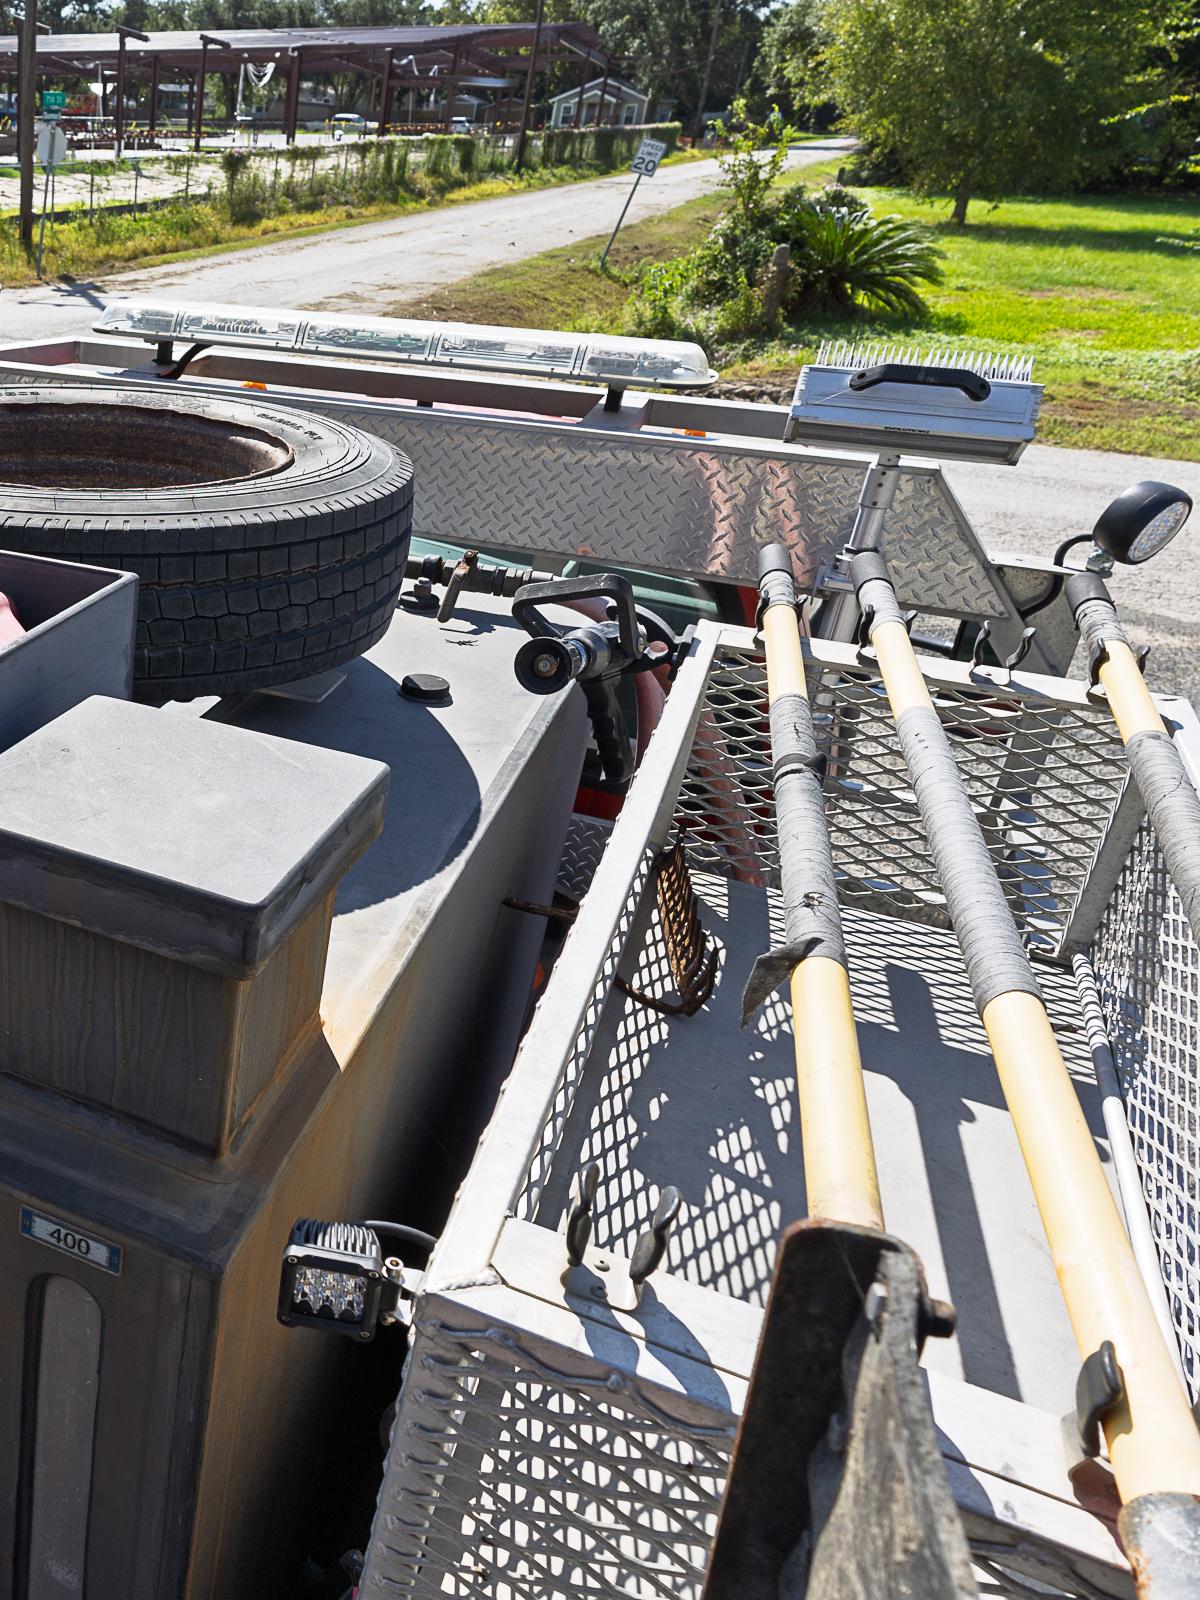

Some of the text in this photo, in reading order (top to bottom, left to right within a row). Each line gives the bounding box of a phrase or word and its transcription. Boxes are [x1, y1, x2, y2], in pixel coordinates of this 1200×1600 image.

[643, 141, 664, 151] SPEED
[634, 156, 657, 172] 20
[49, 1228, 90, 1255] 400
